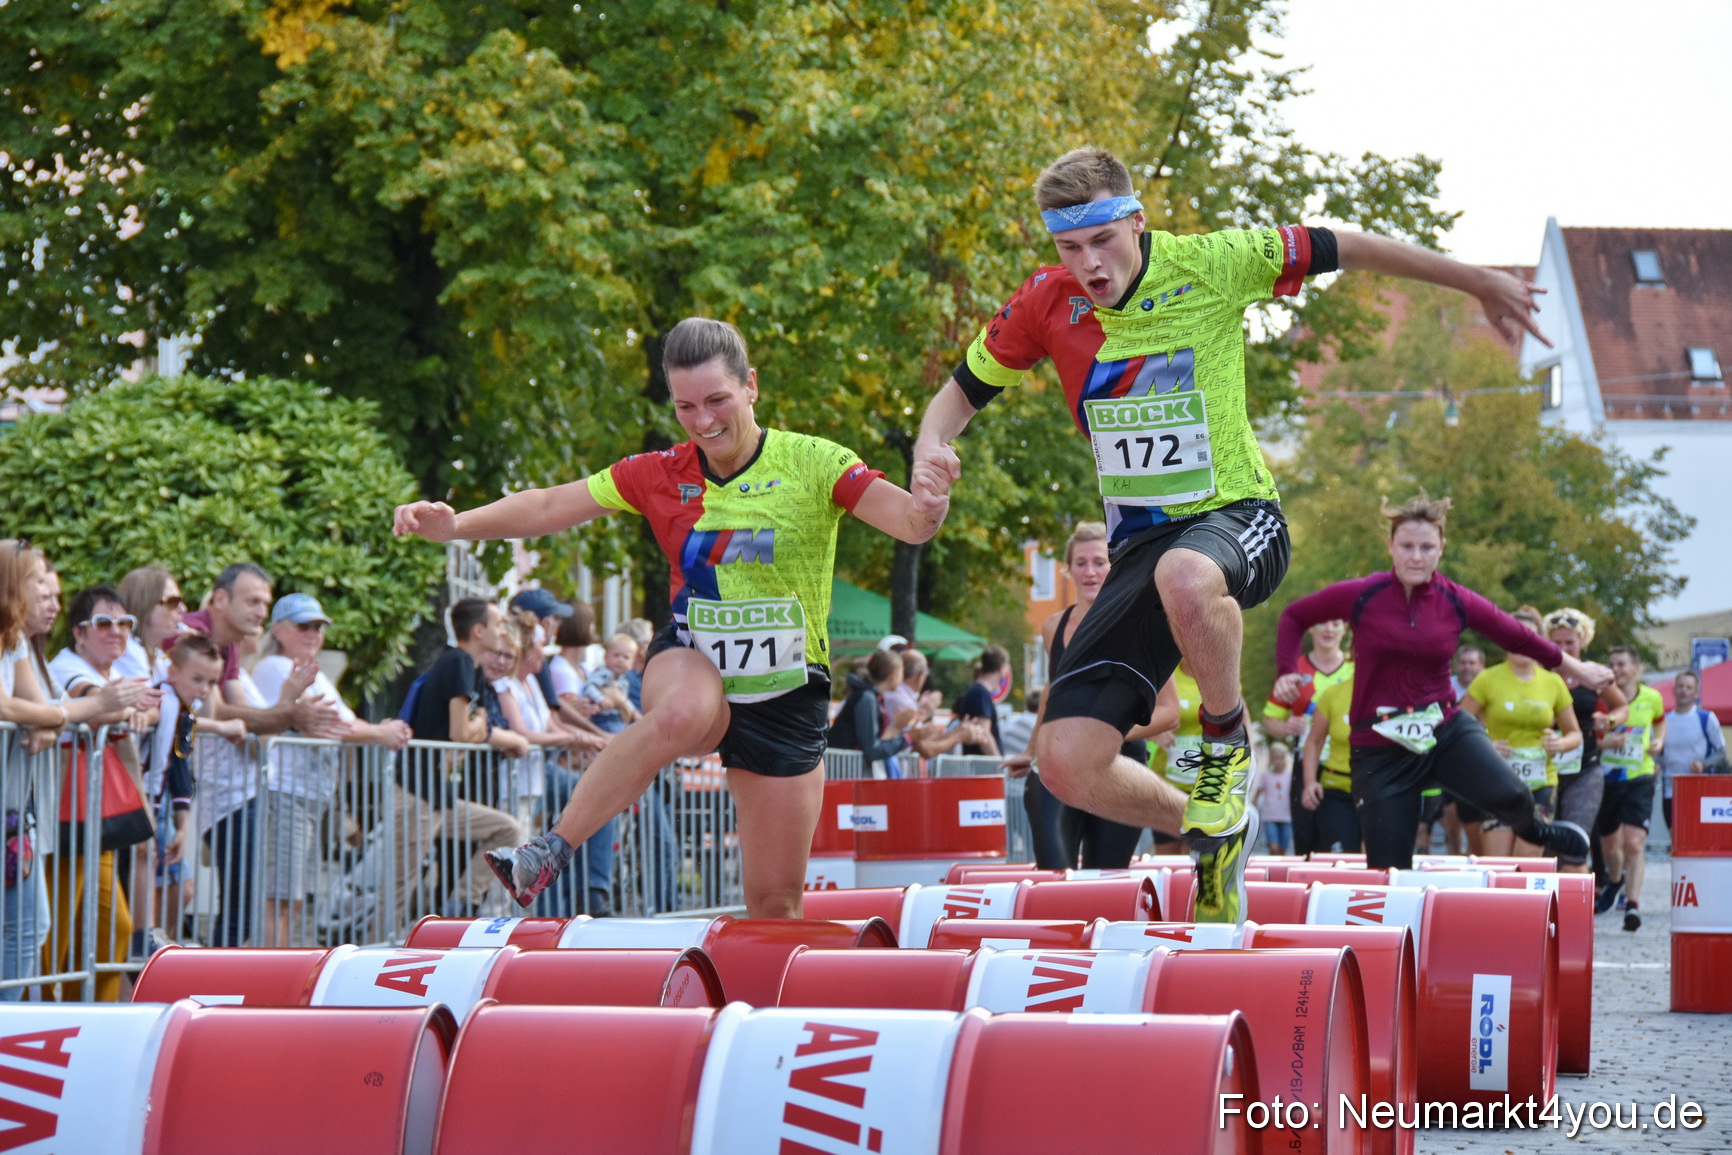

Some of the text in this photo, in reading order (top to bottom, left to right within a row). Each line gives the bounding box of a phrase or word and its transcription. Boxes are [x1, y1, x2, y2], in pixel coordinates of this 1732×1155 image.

[1092, 397, 1196, 428] BOCK
[1114, 434, 1183, 469] 172
[694, 602, 796, 630] BOCK
[711, 637, 777, 670] 171
